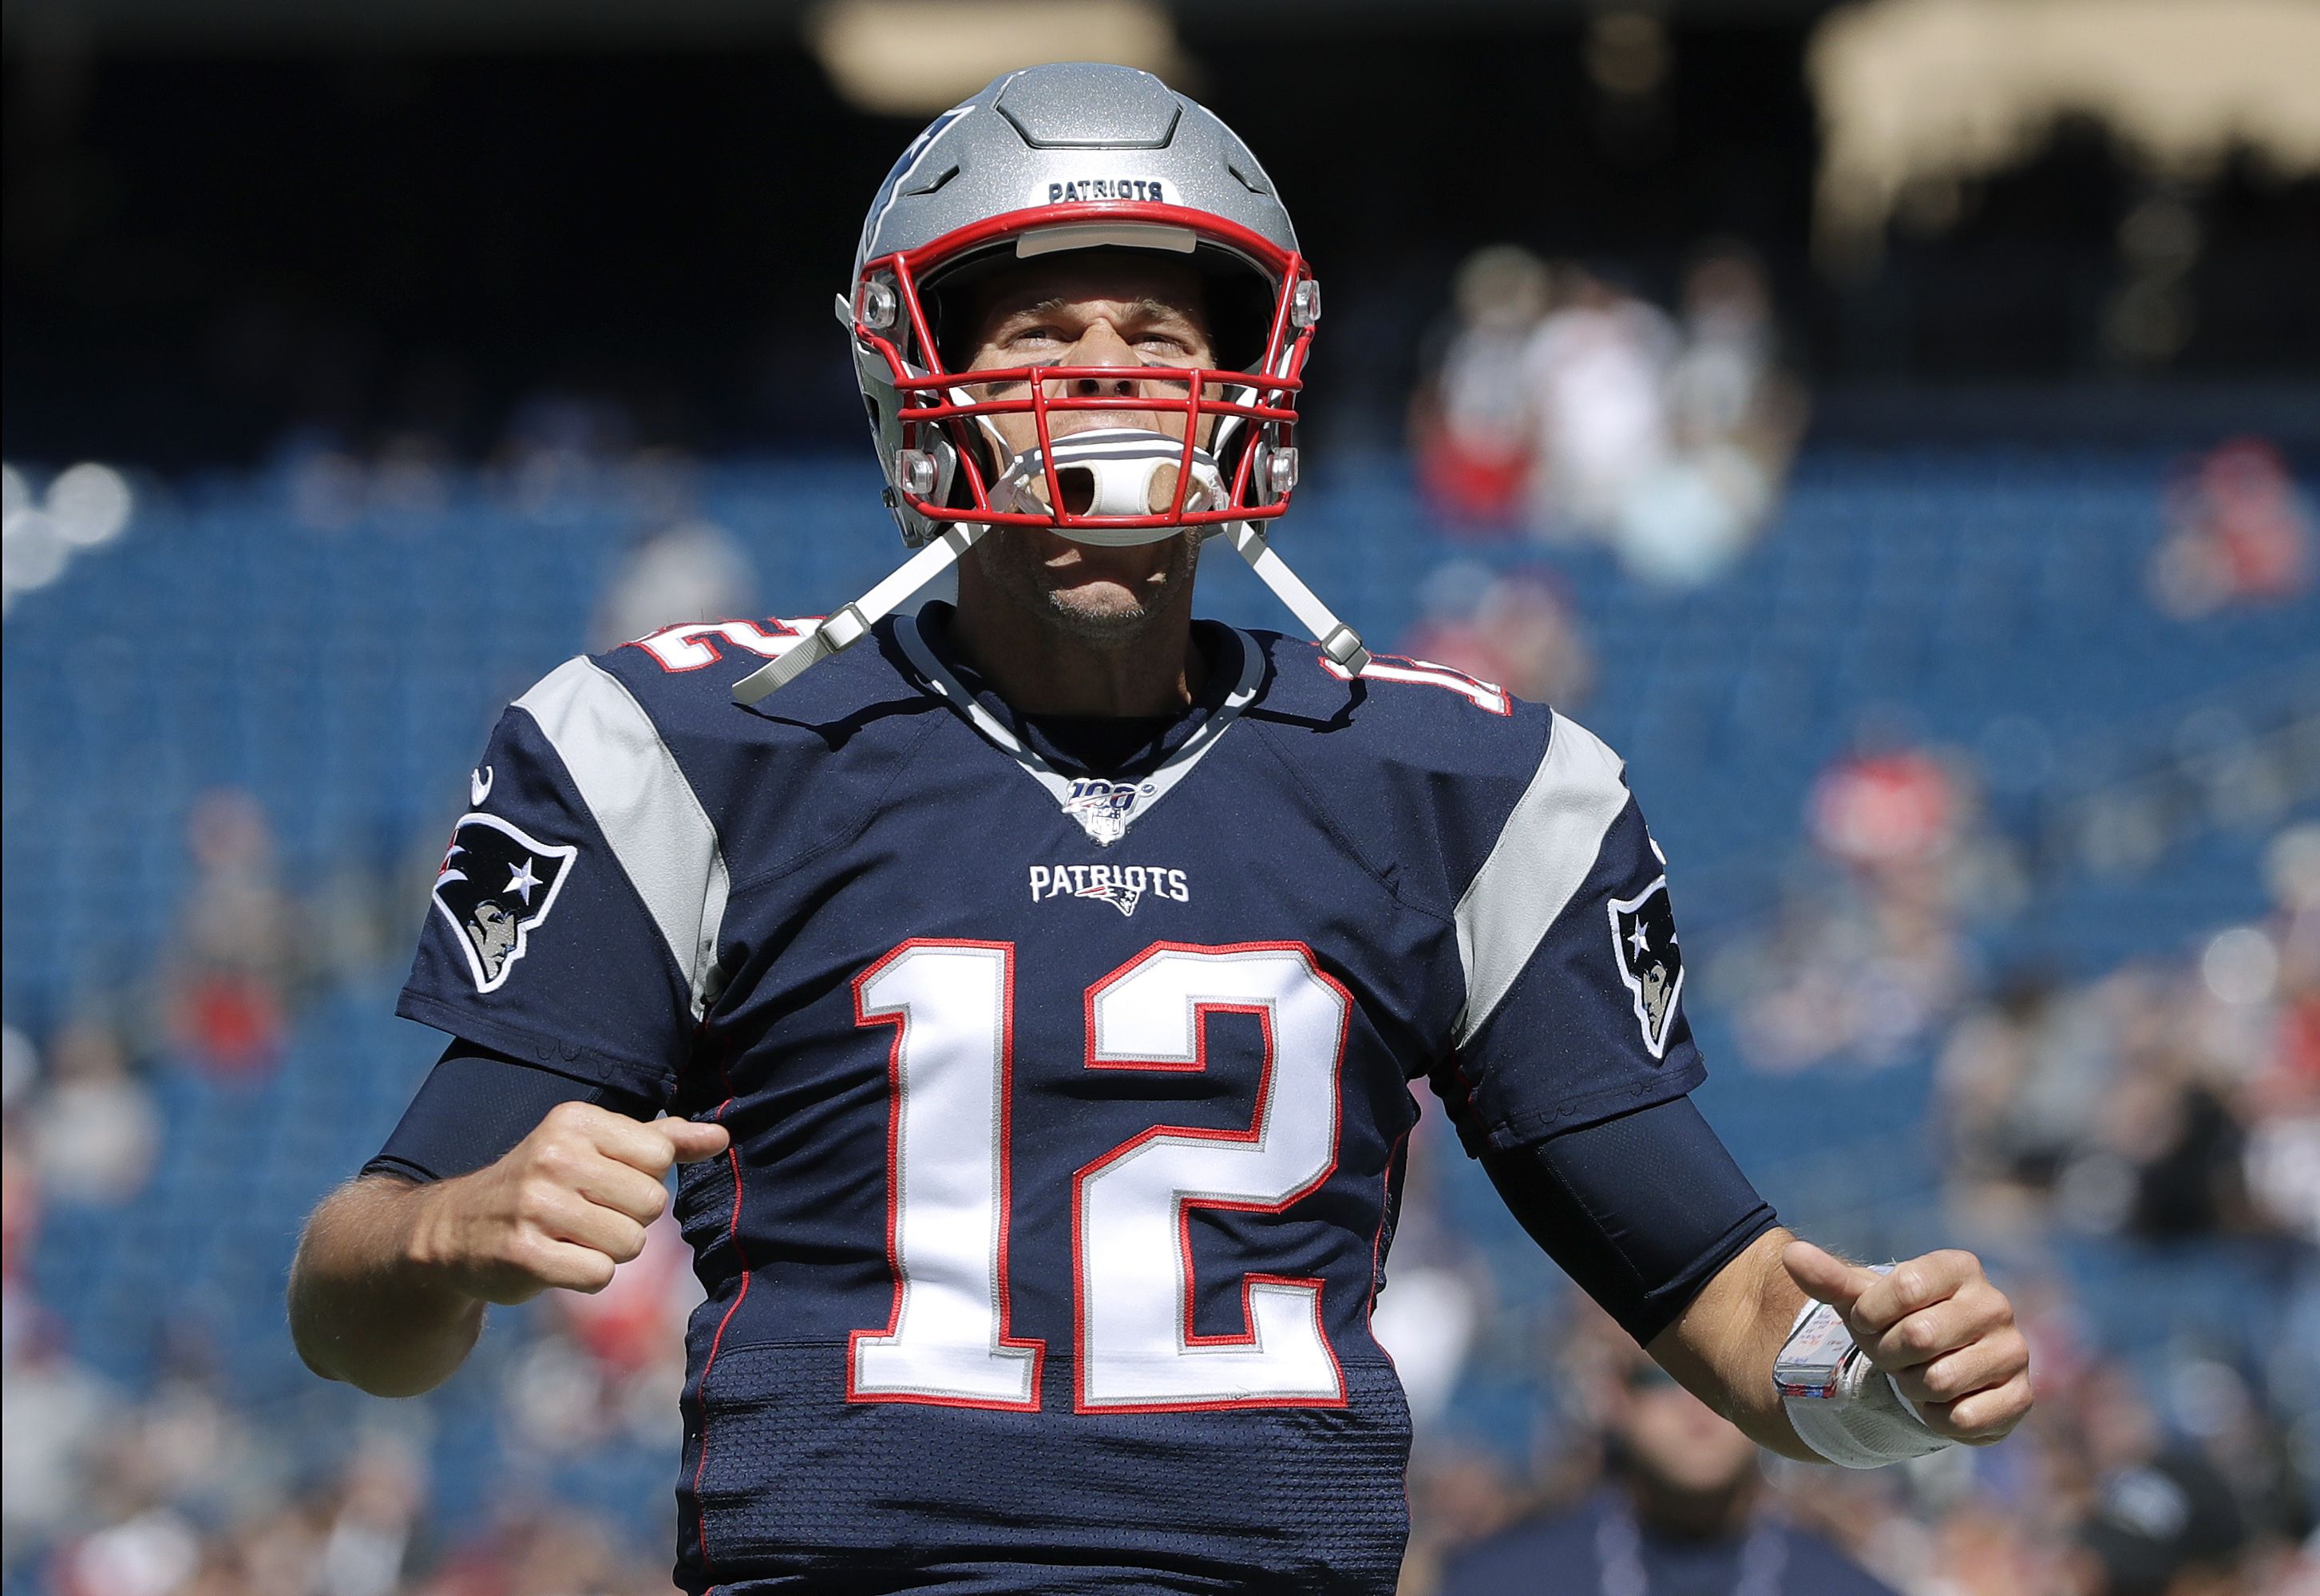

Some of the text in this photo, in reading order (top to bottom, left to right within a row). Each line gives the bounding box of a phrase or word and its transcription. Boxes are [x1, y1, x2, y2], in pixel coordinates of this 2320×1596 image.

[1049, 180, 1162, 204] PATRIOTS
[1029, 865, 1190, 903] PATRIOTS
[845, 937, 1354, 1415] 12
